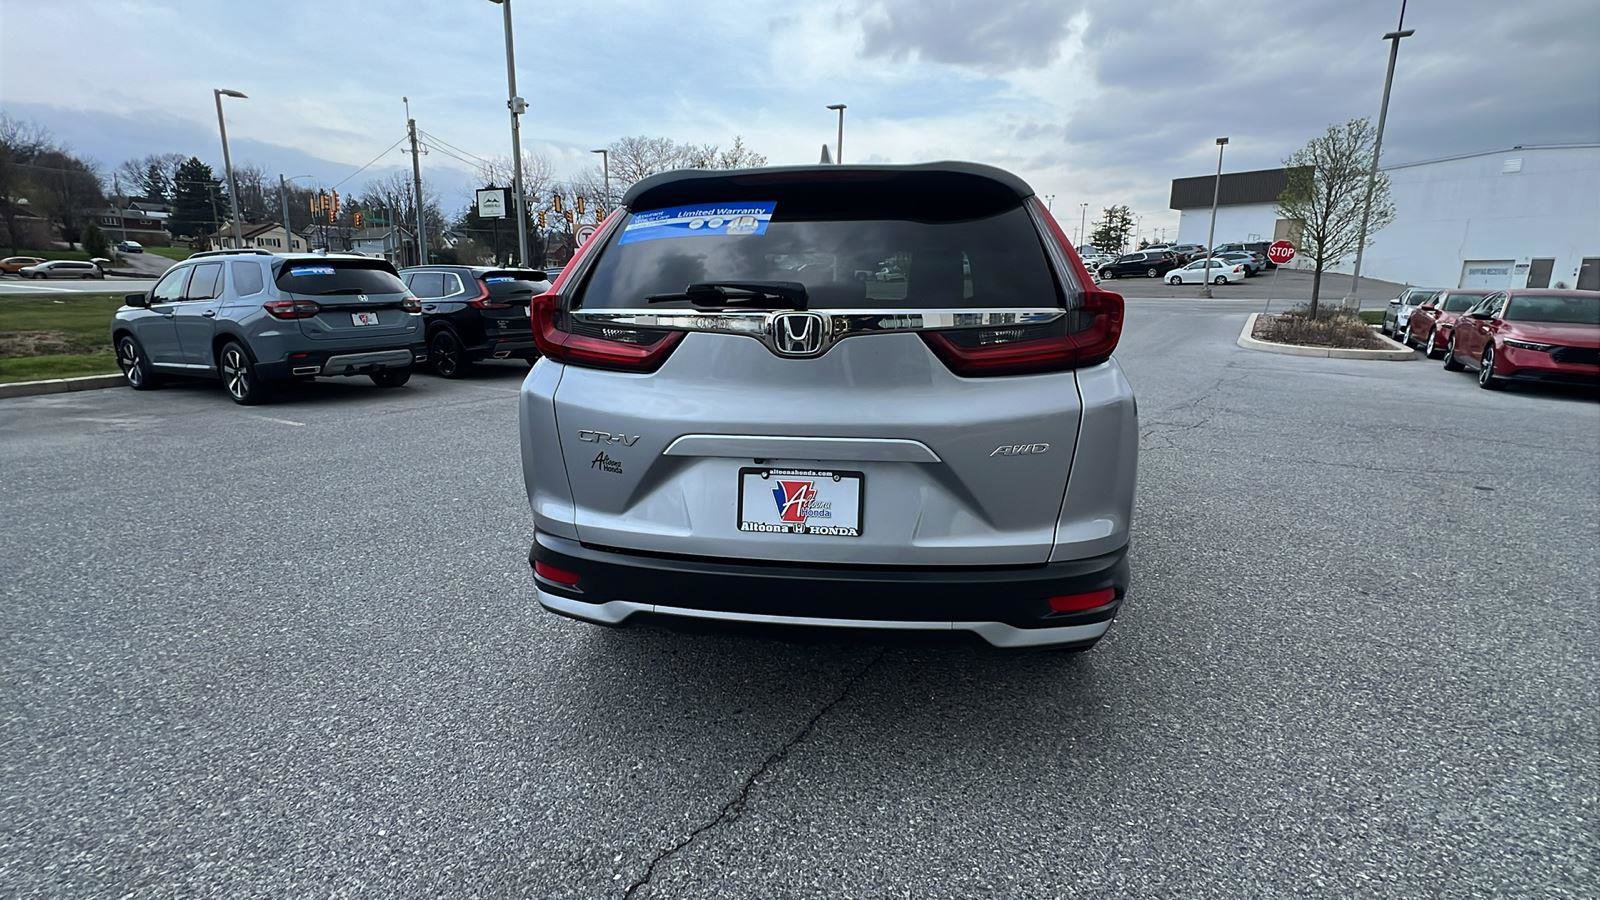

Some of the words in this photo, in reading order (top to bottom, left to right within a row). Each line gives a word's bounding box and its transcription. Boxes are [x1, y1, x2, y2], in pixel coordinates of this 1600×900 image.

[677, 209, 716, 218] Limited
[717, 208, 766, 216] Warranty
[1269, 246, 1295, 257] STOP
[578, 429, 641, 447] CR-V
[989, 443, 1050, 457] AWD
[769, 469, 833, 477] altoonahonda.com
[801, 508, 832, 518] Honda
[740, 522, 789, 533] Altoona
[810, 526, 859, 537] HONDA
